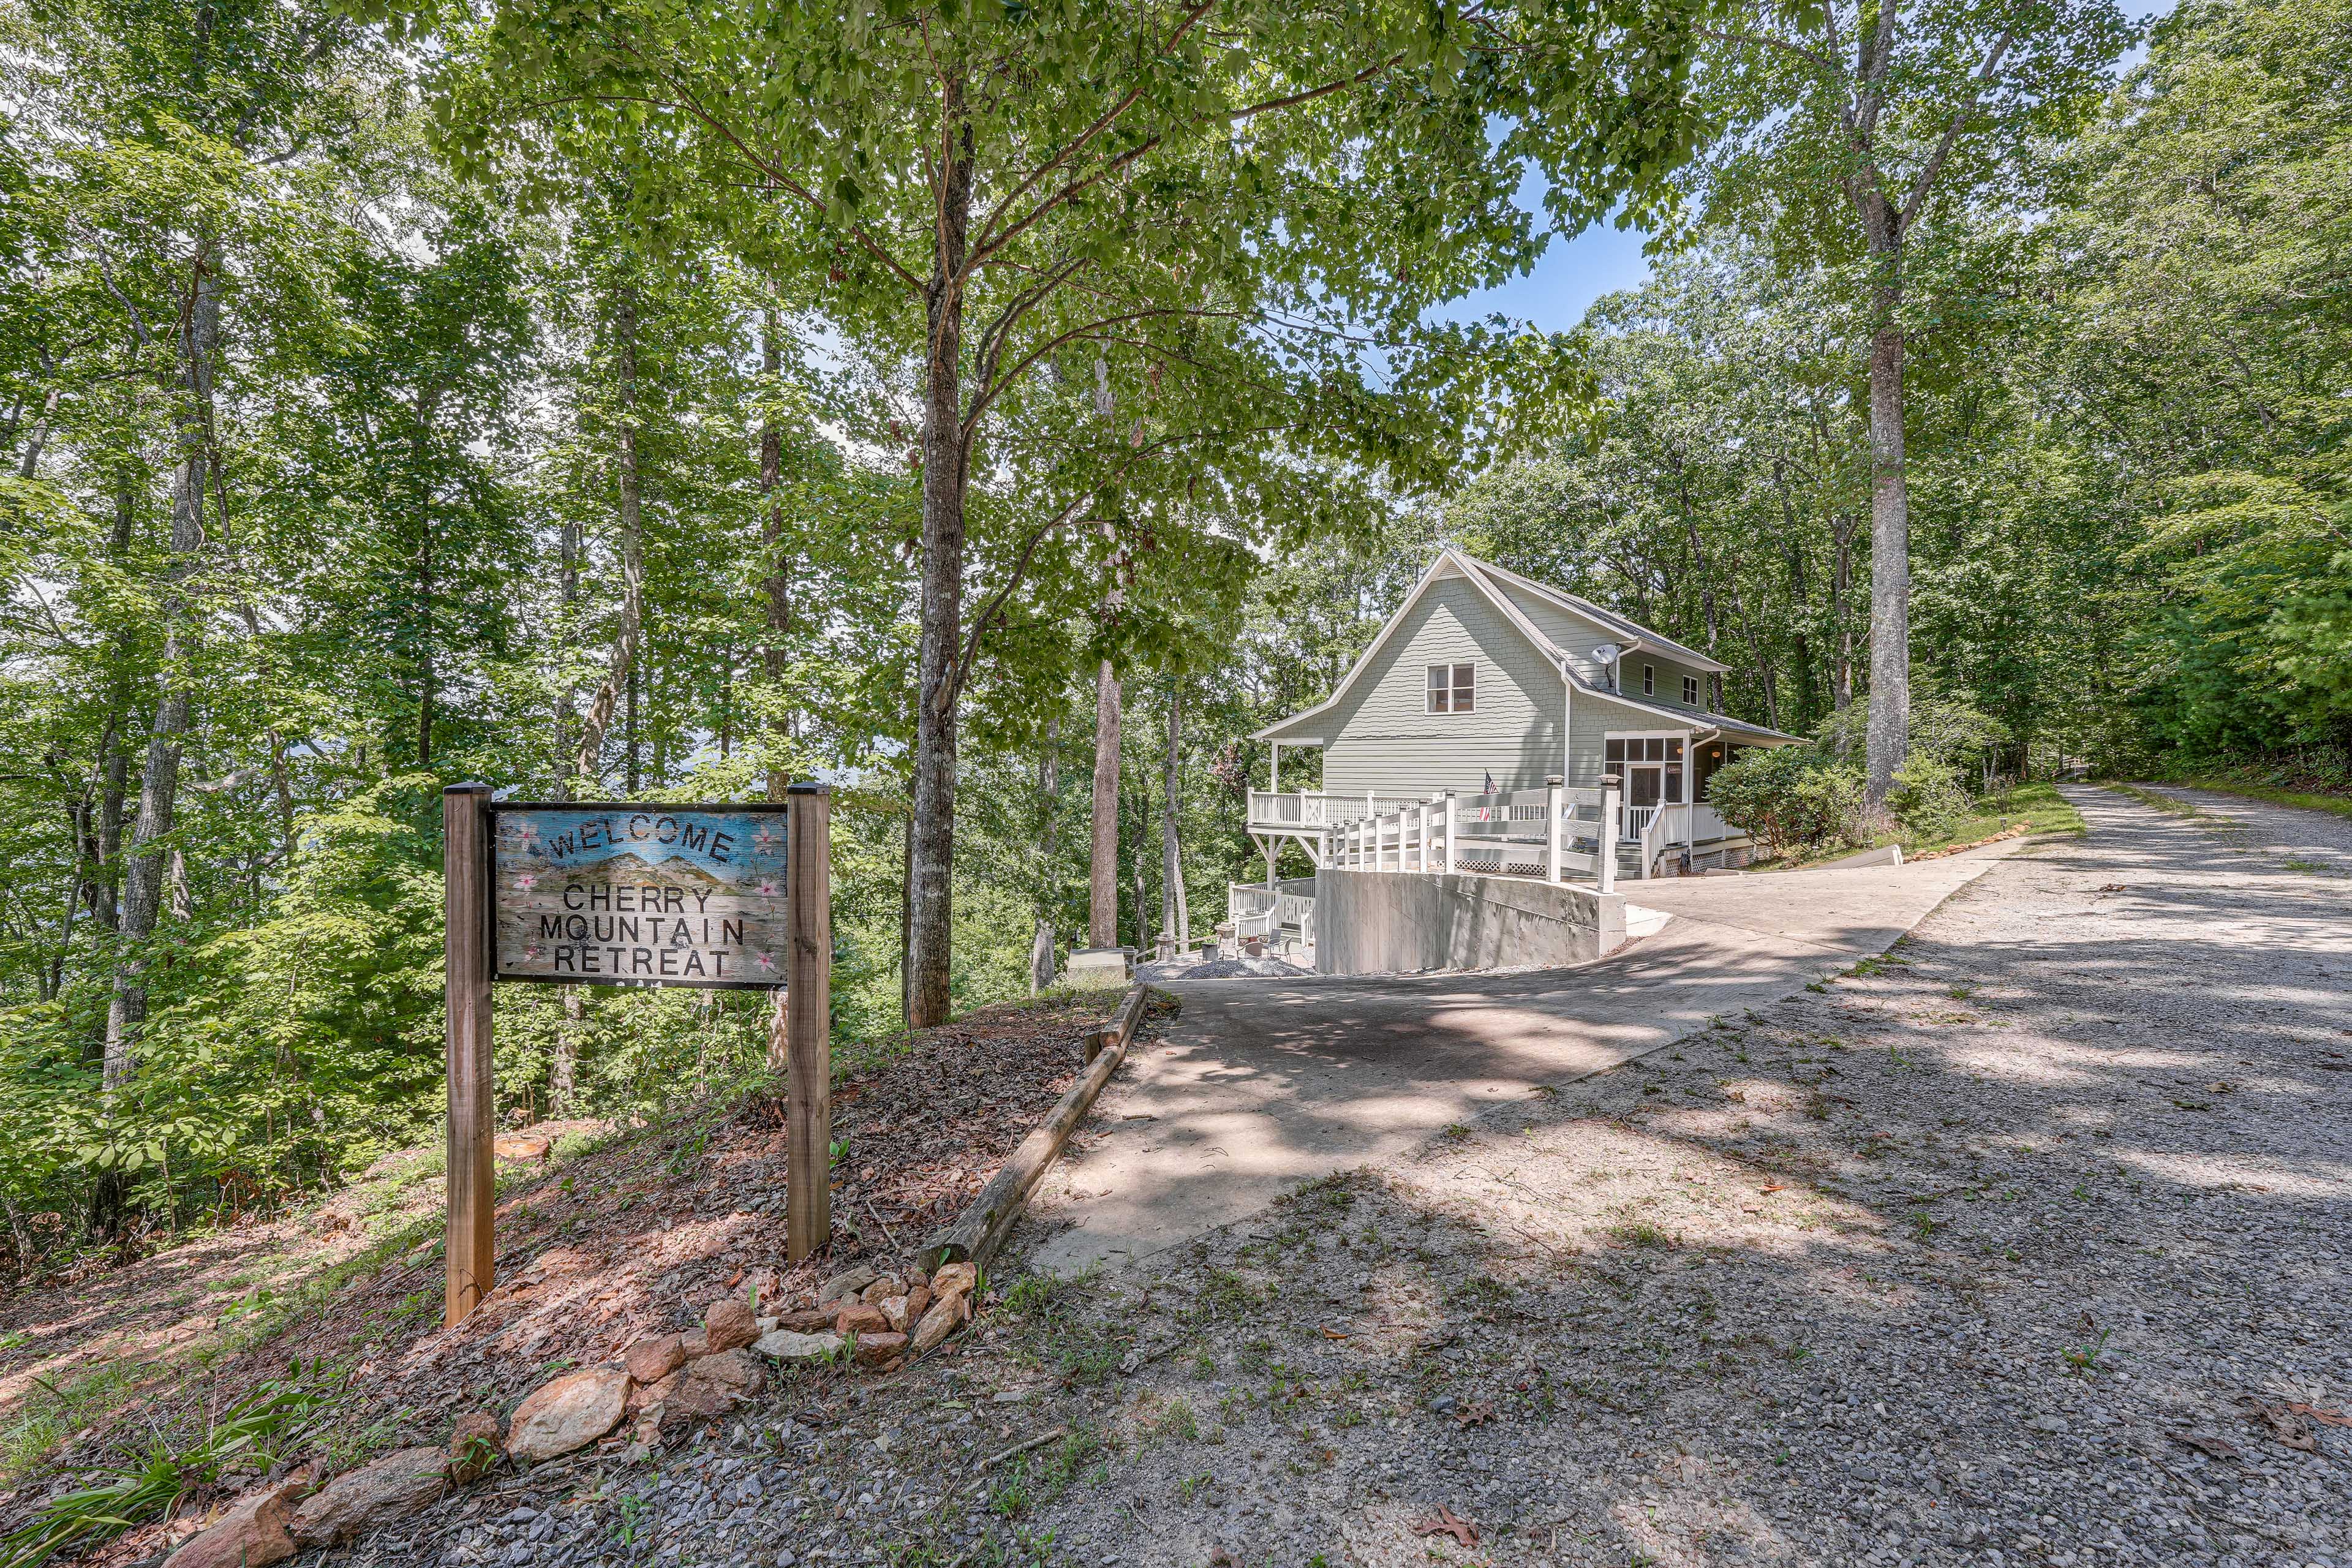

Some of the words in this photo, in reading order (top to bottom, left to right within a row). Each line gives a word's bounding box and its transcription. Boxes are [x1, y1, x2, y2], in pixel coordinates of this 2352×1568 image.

[549, 815, 734, 863] WELCOME
[564, 884, 713, 913] CHERRY
[540, 914, 744, 946] MOUNTAIN
[554, 945, 729, 977] RETREAT
